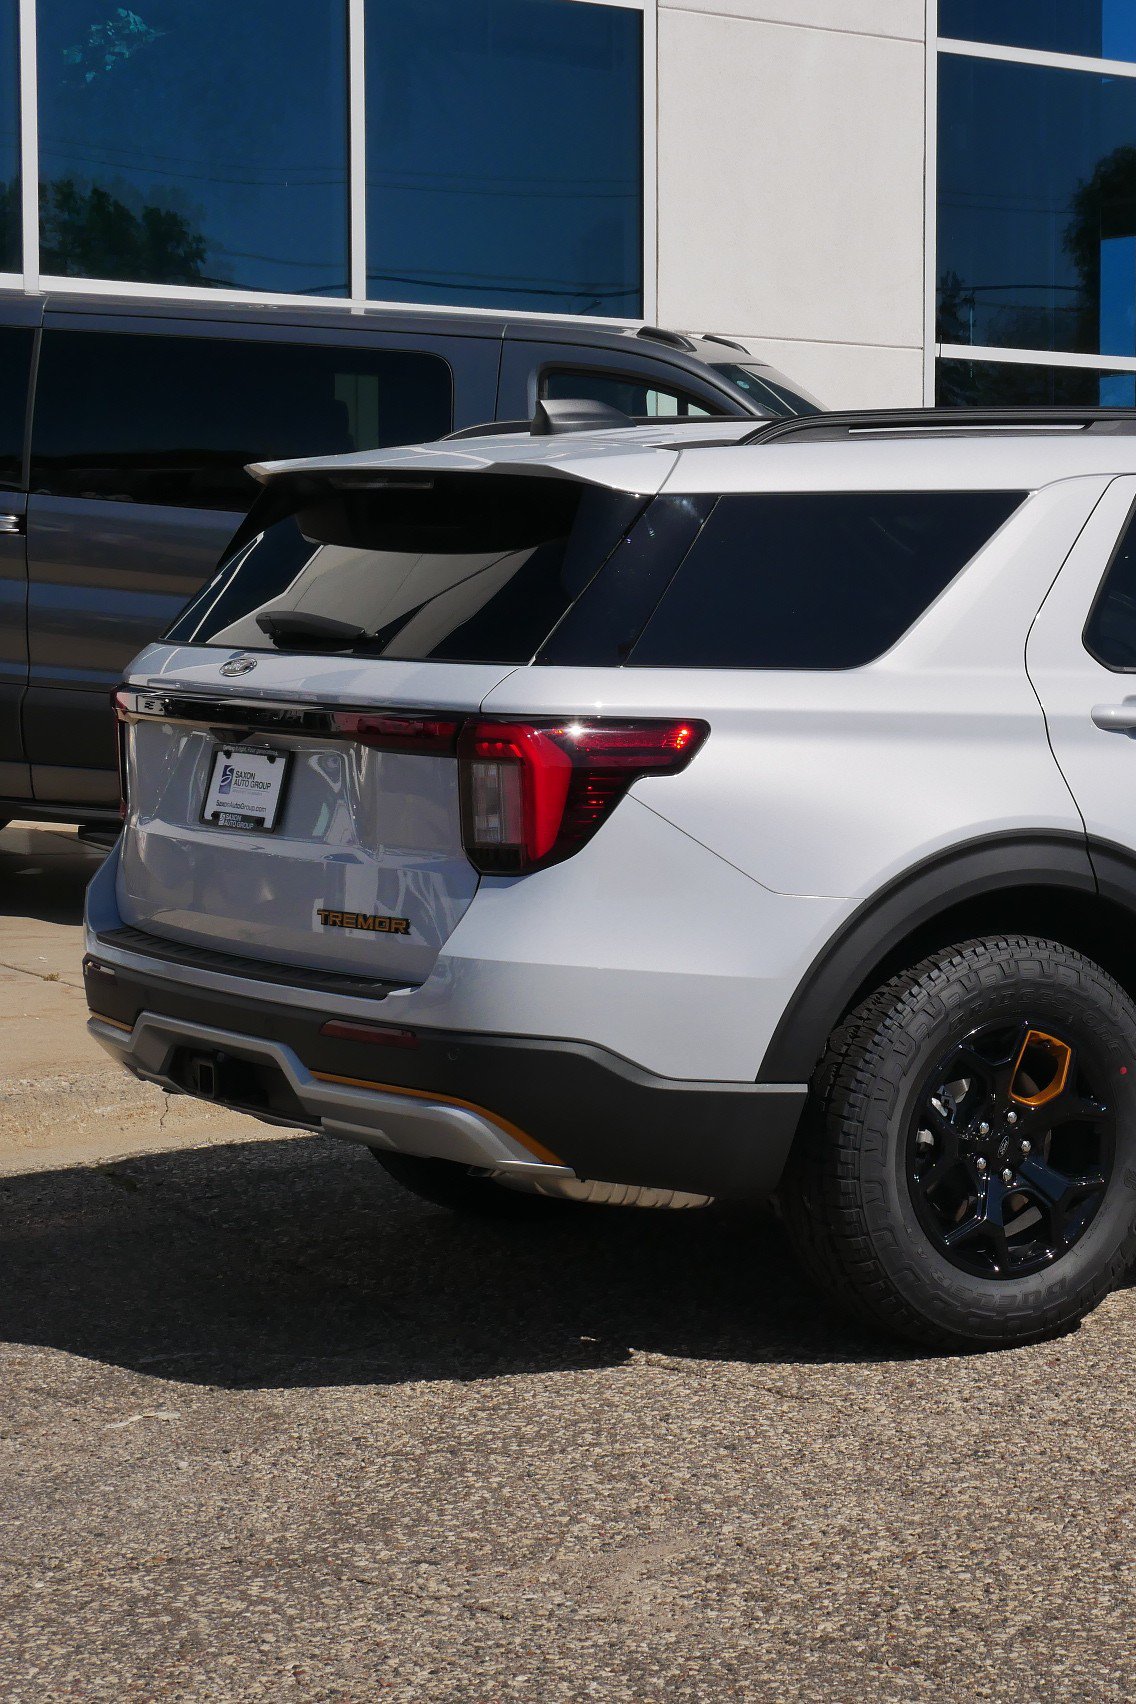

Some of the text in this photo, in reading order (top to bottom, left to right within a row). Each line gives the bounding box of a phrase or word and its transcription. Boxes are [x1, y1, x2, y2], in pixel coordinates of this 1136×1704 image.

[235, 770, 256, 780] SAXON
[233, 779, 272, 790] AUTO GROUP
[216, 800, 267, 812] SaxonAutoGroup.com
[236, 821, 254, 829] GROUP
[316, 908, 412, 936] TREMOR
